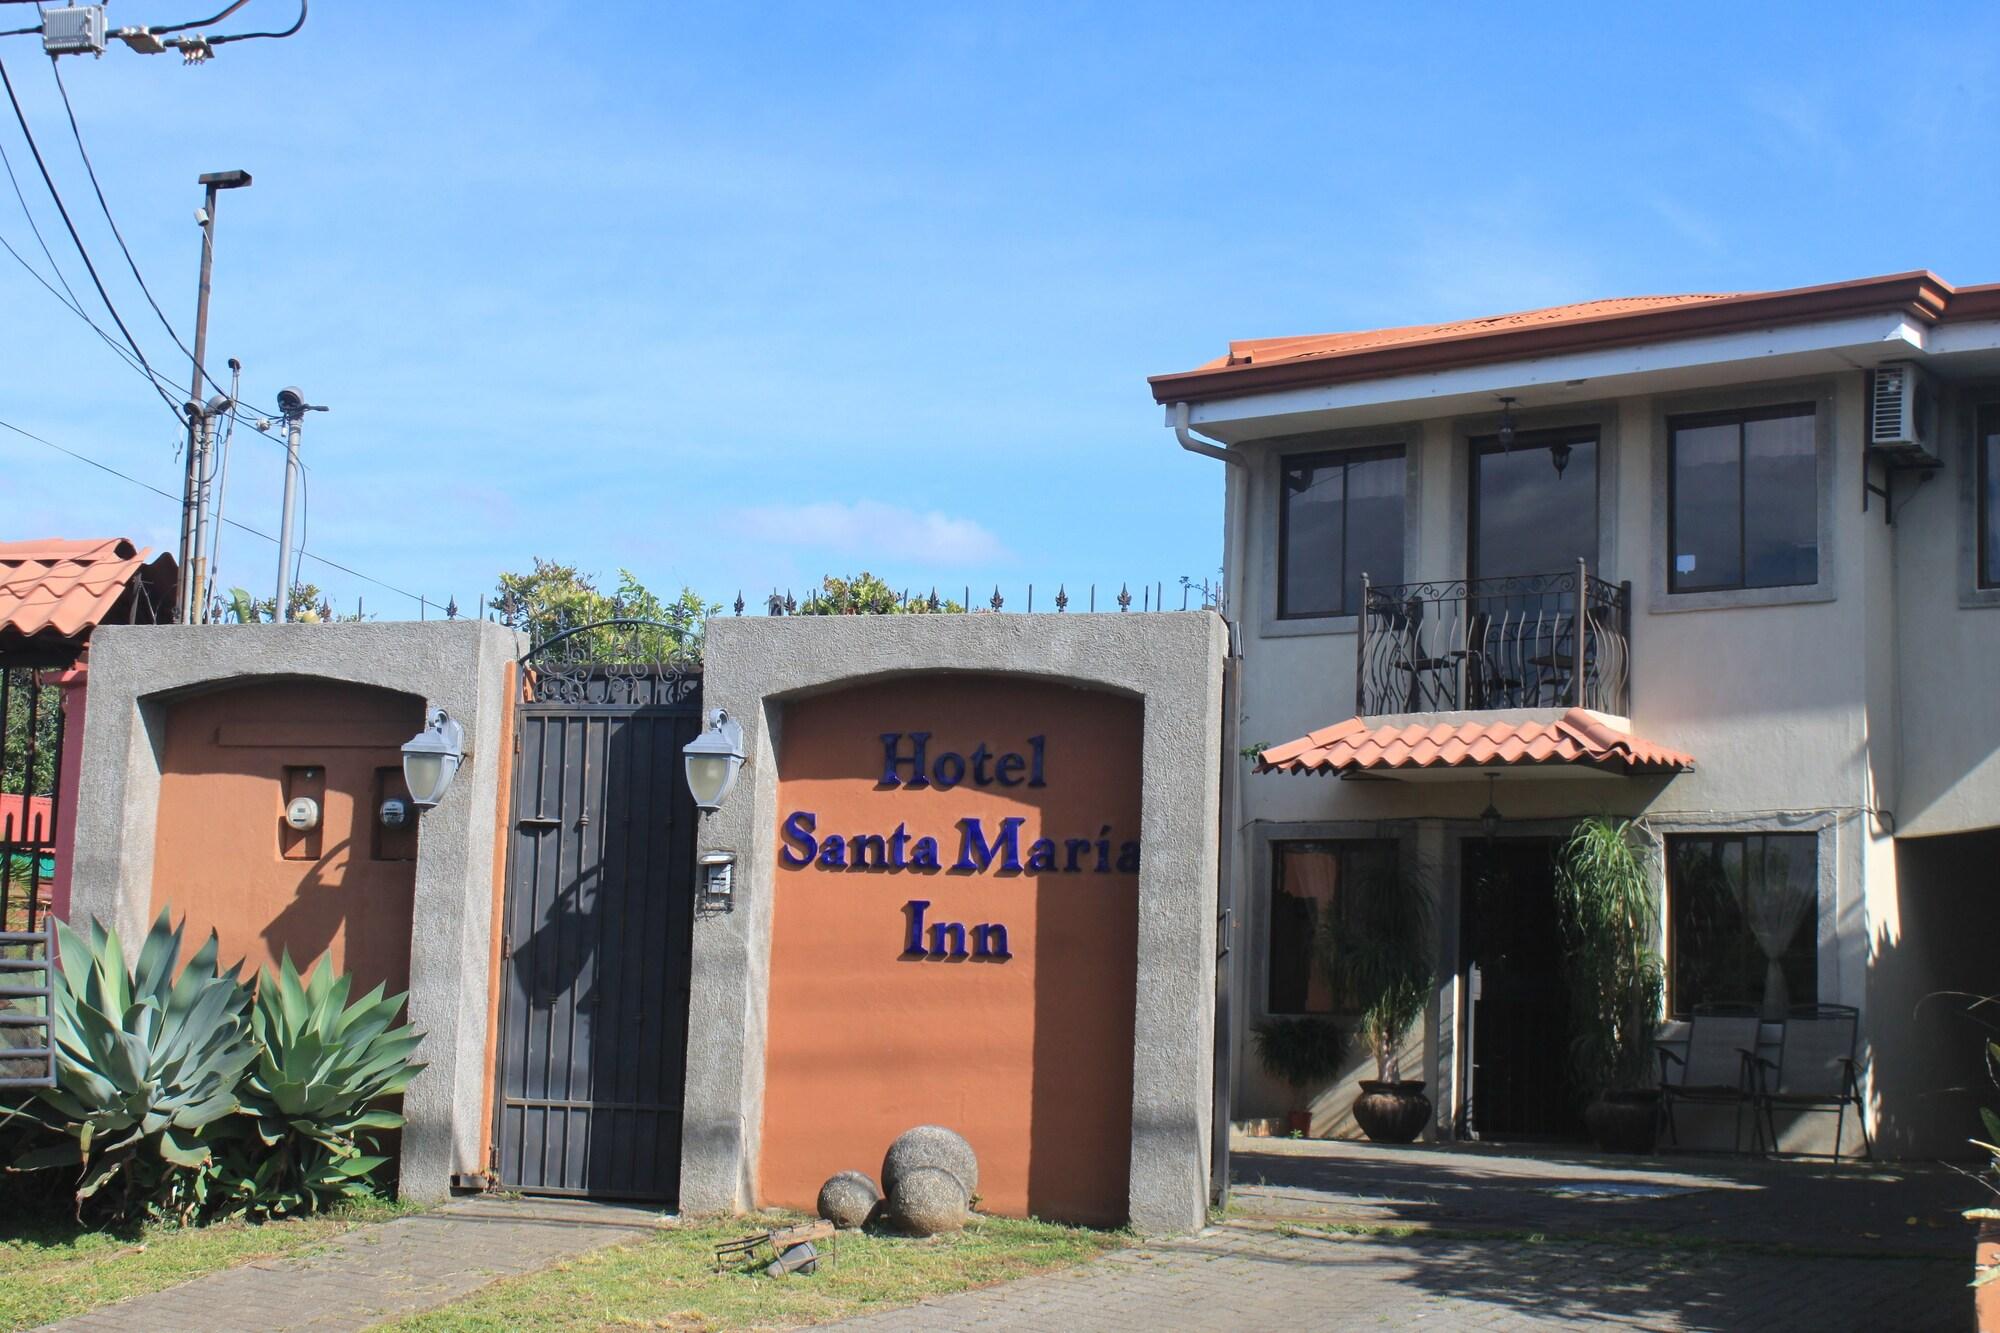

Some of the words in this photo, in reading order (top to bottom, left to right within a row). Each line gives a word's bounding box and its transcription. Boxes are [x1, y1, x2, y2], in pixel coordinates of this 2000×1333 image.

[877, 731, 1047, 789] Hotel
[780, 811, 941, 873] Santa
[951, 817, 1140, 876] María
[899, 900, 1012, 961] Inn
